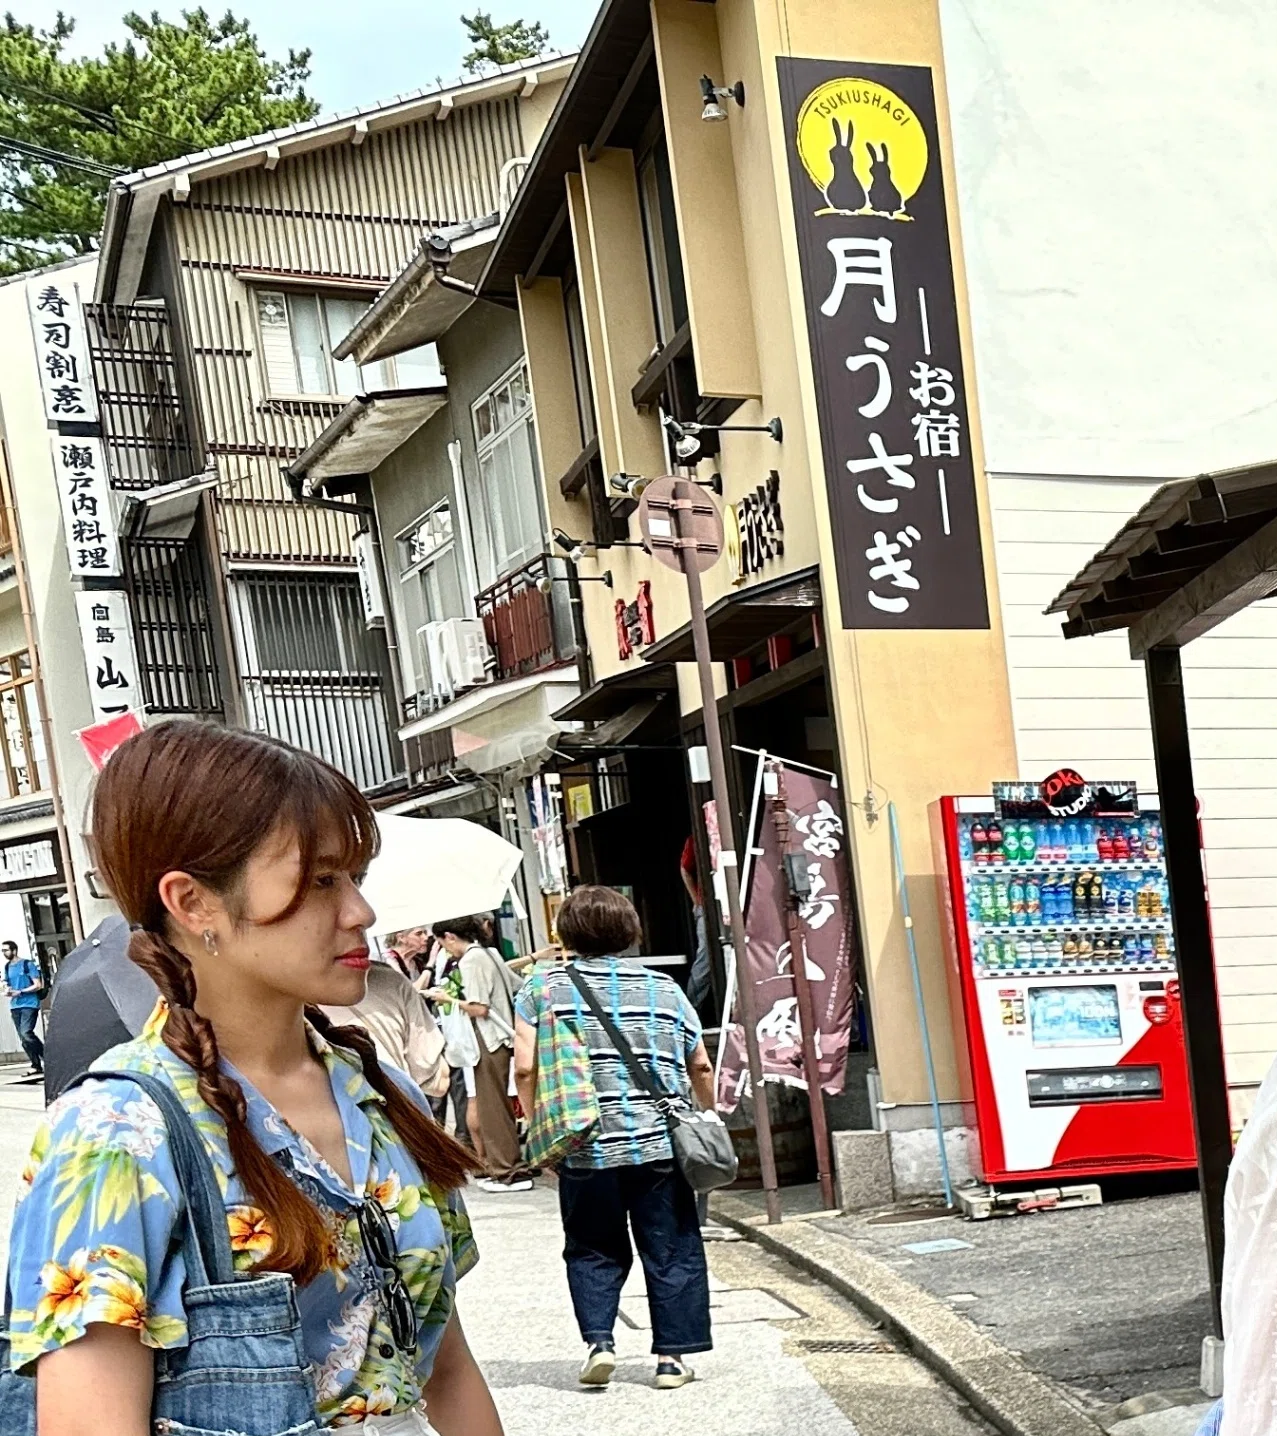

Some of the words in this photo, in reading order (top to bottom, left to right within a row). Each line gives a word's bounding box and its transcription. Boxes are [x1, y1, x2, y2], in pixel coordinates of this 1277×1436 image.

[813, 89, 911, 127] TSUKIUSHAGI
[820, 236, 924, 614] 月うさぎ
[907, 360, 962, 459] お宿
[59, 443, 111, 571] 瀬戸内料理
